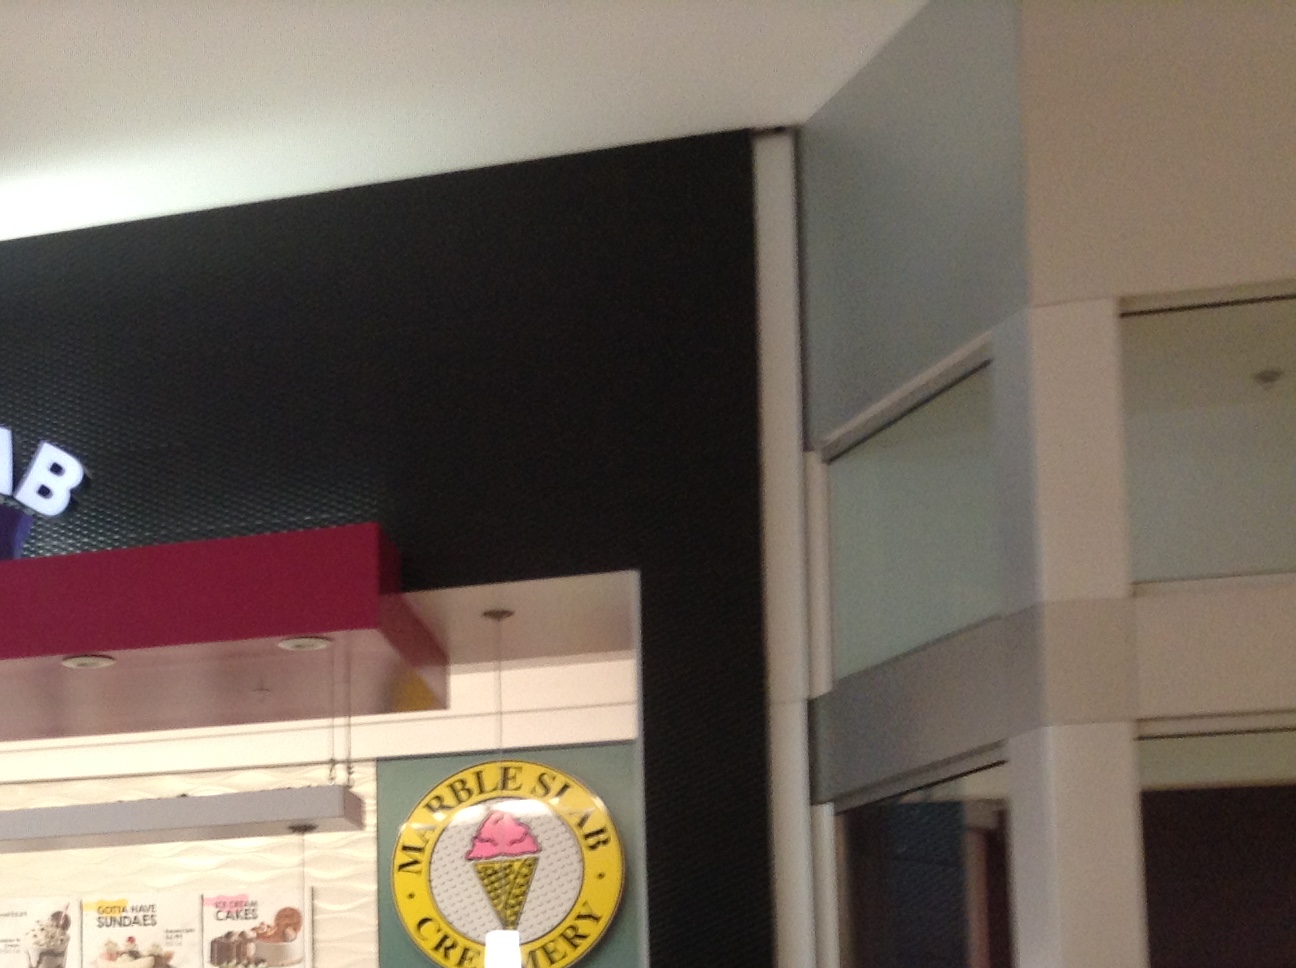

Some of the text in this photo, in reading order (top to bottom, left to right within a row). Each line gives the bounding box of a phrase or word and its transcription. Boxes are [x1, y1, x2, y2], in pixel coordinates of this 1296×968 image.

[97, 904, 157, 915] GOTTA HAVE
[215, 908, 259, 921] CAKES
[97, 914, 158, 928] SUNDAES
